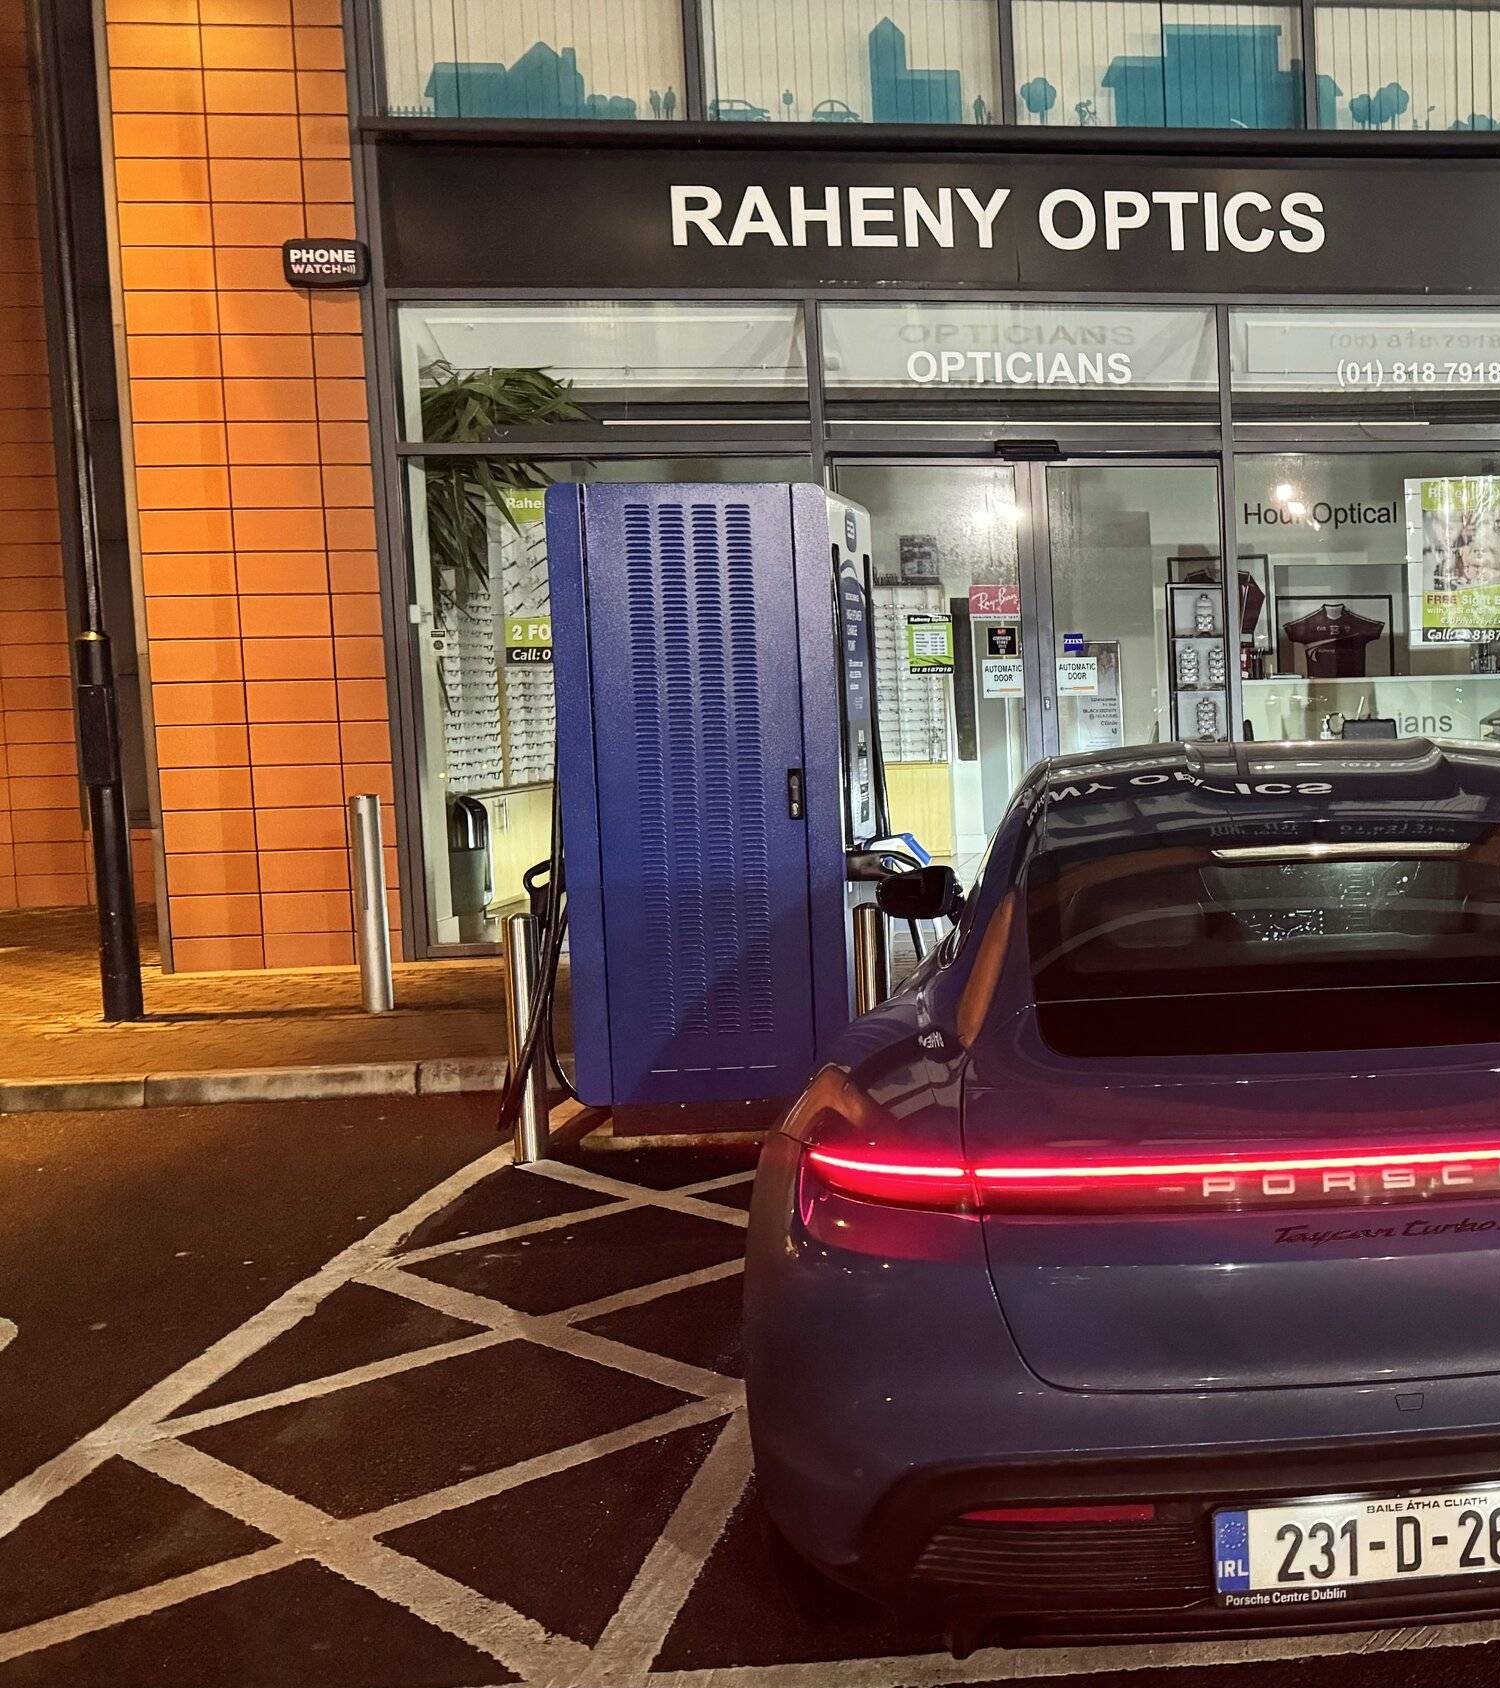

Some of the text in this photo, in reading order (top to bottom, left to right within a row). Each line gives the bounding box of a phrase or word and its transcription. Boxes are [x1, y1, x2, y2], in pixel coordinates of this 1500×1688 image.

[669, 184, 1326, 254] RAHENY OPTICS
[289, 248, 356, 263] PHONE
[291, 264, 342, 274] WATCH
[906, 350, 1133, 384] OPTICIANS
[1336, 359, 1384, 387] (01)
[1392, 362, 1437, 384] 818
[506, 497, 545, 510] Rahe
[1312, 502, 1397, 529] Optical
[1426, 594, 1457, 605] FREE
[511, 624, 523, 641] 2
[984, 664, 1023, 673] AUTOMATIC
[1058, 662, 1096, 671] AUTOMATIC
[993, 674, 1014, 682] DOOR
[1067, 672, 1087, 680] DOOR
[1274, 1222, 1396, 1249] Taycan
[1400, 1218, 1499, 1238] turbo
[1366, 1496, 1488, 1514] BAILE ÁTHA CLIATH
[1218, 1560, 1249, 1579] IRL
[1225, 1587, 1347, 1607] Porsche Centre Dublin
